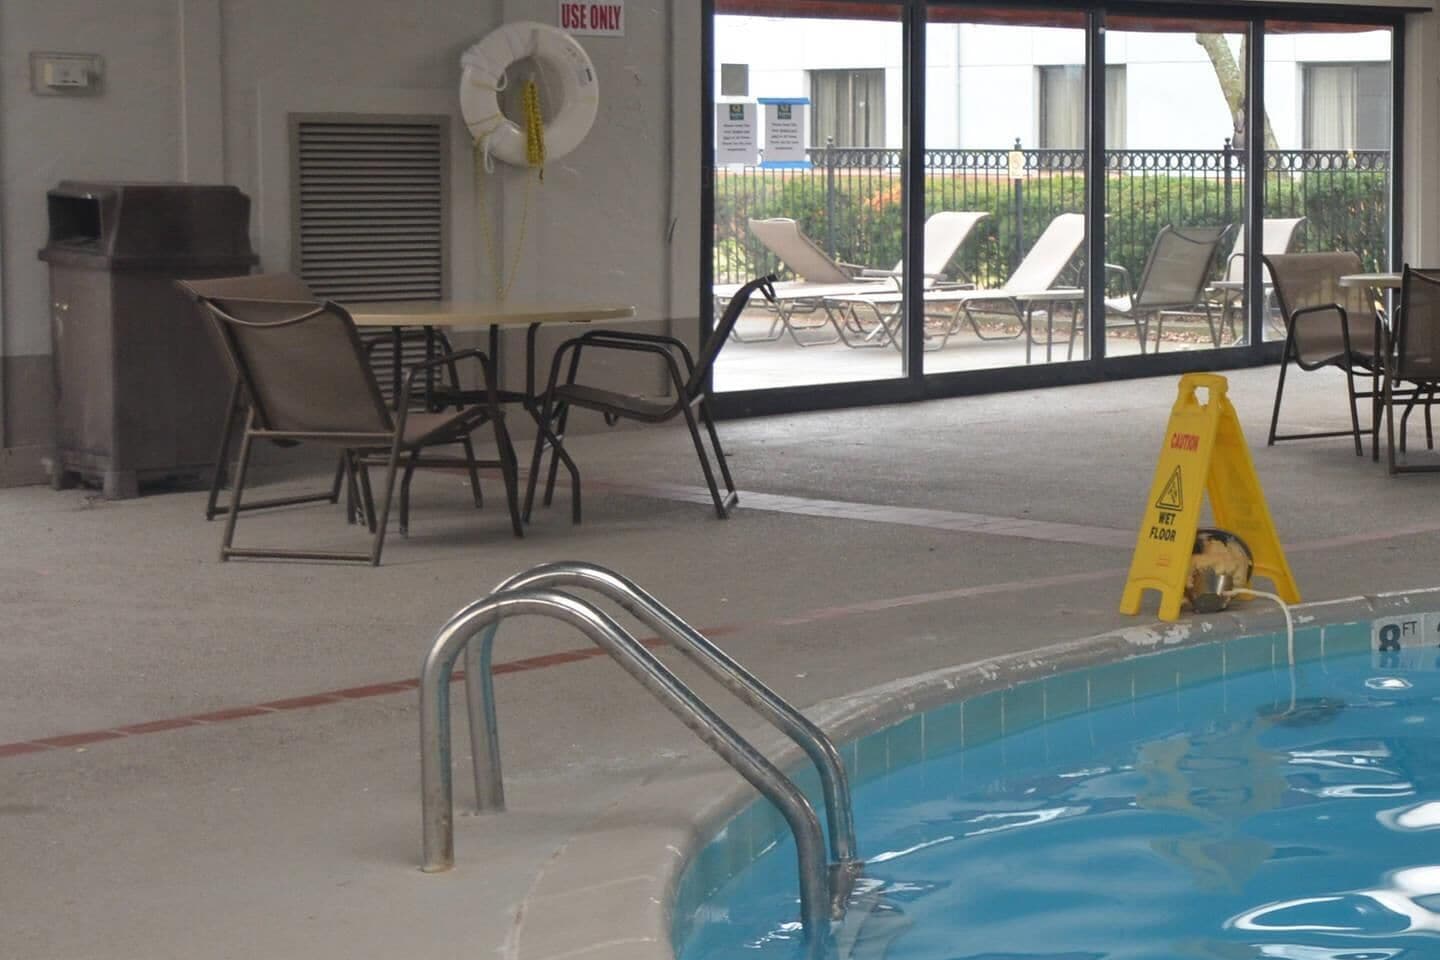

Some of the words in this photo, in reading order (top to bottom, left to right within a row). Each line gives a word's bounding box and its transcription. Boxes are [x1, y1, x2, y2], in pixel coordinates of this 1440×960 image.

[561, 3, 587, 29] USE
[591, 4, 622, 30] ONLY
[1171, 431, 1200, 452] CAUTION
[1158, 511, 1177, 526] WET
[1149, 525, 1177, 542] FLOOR
